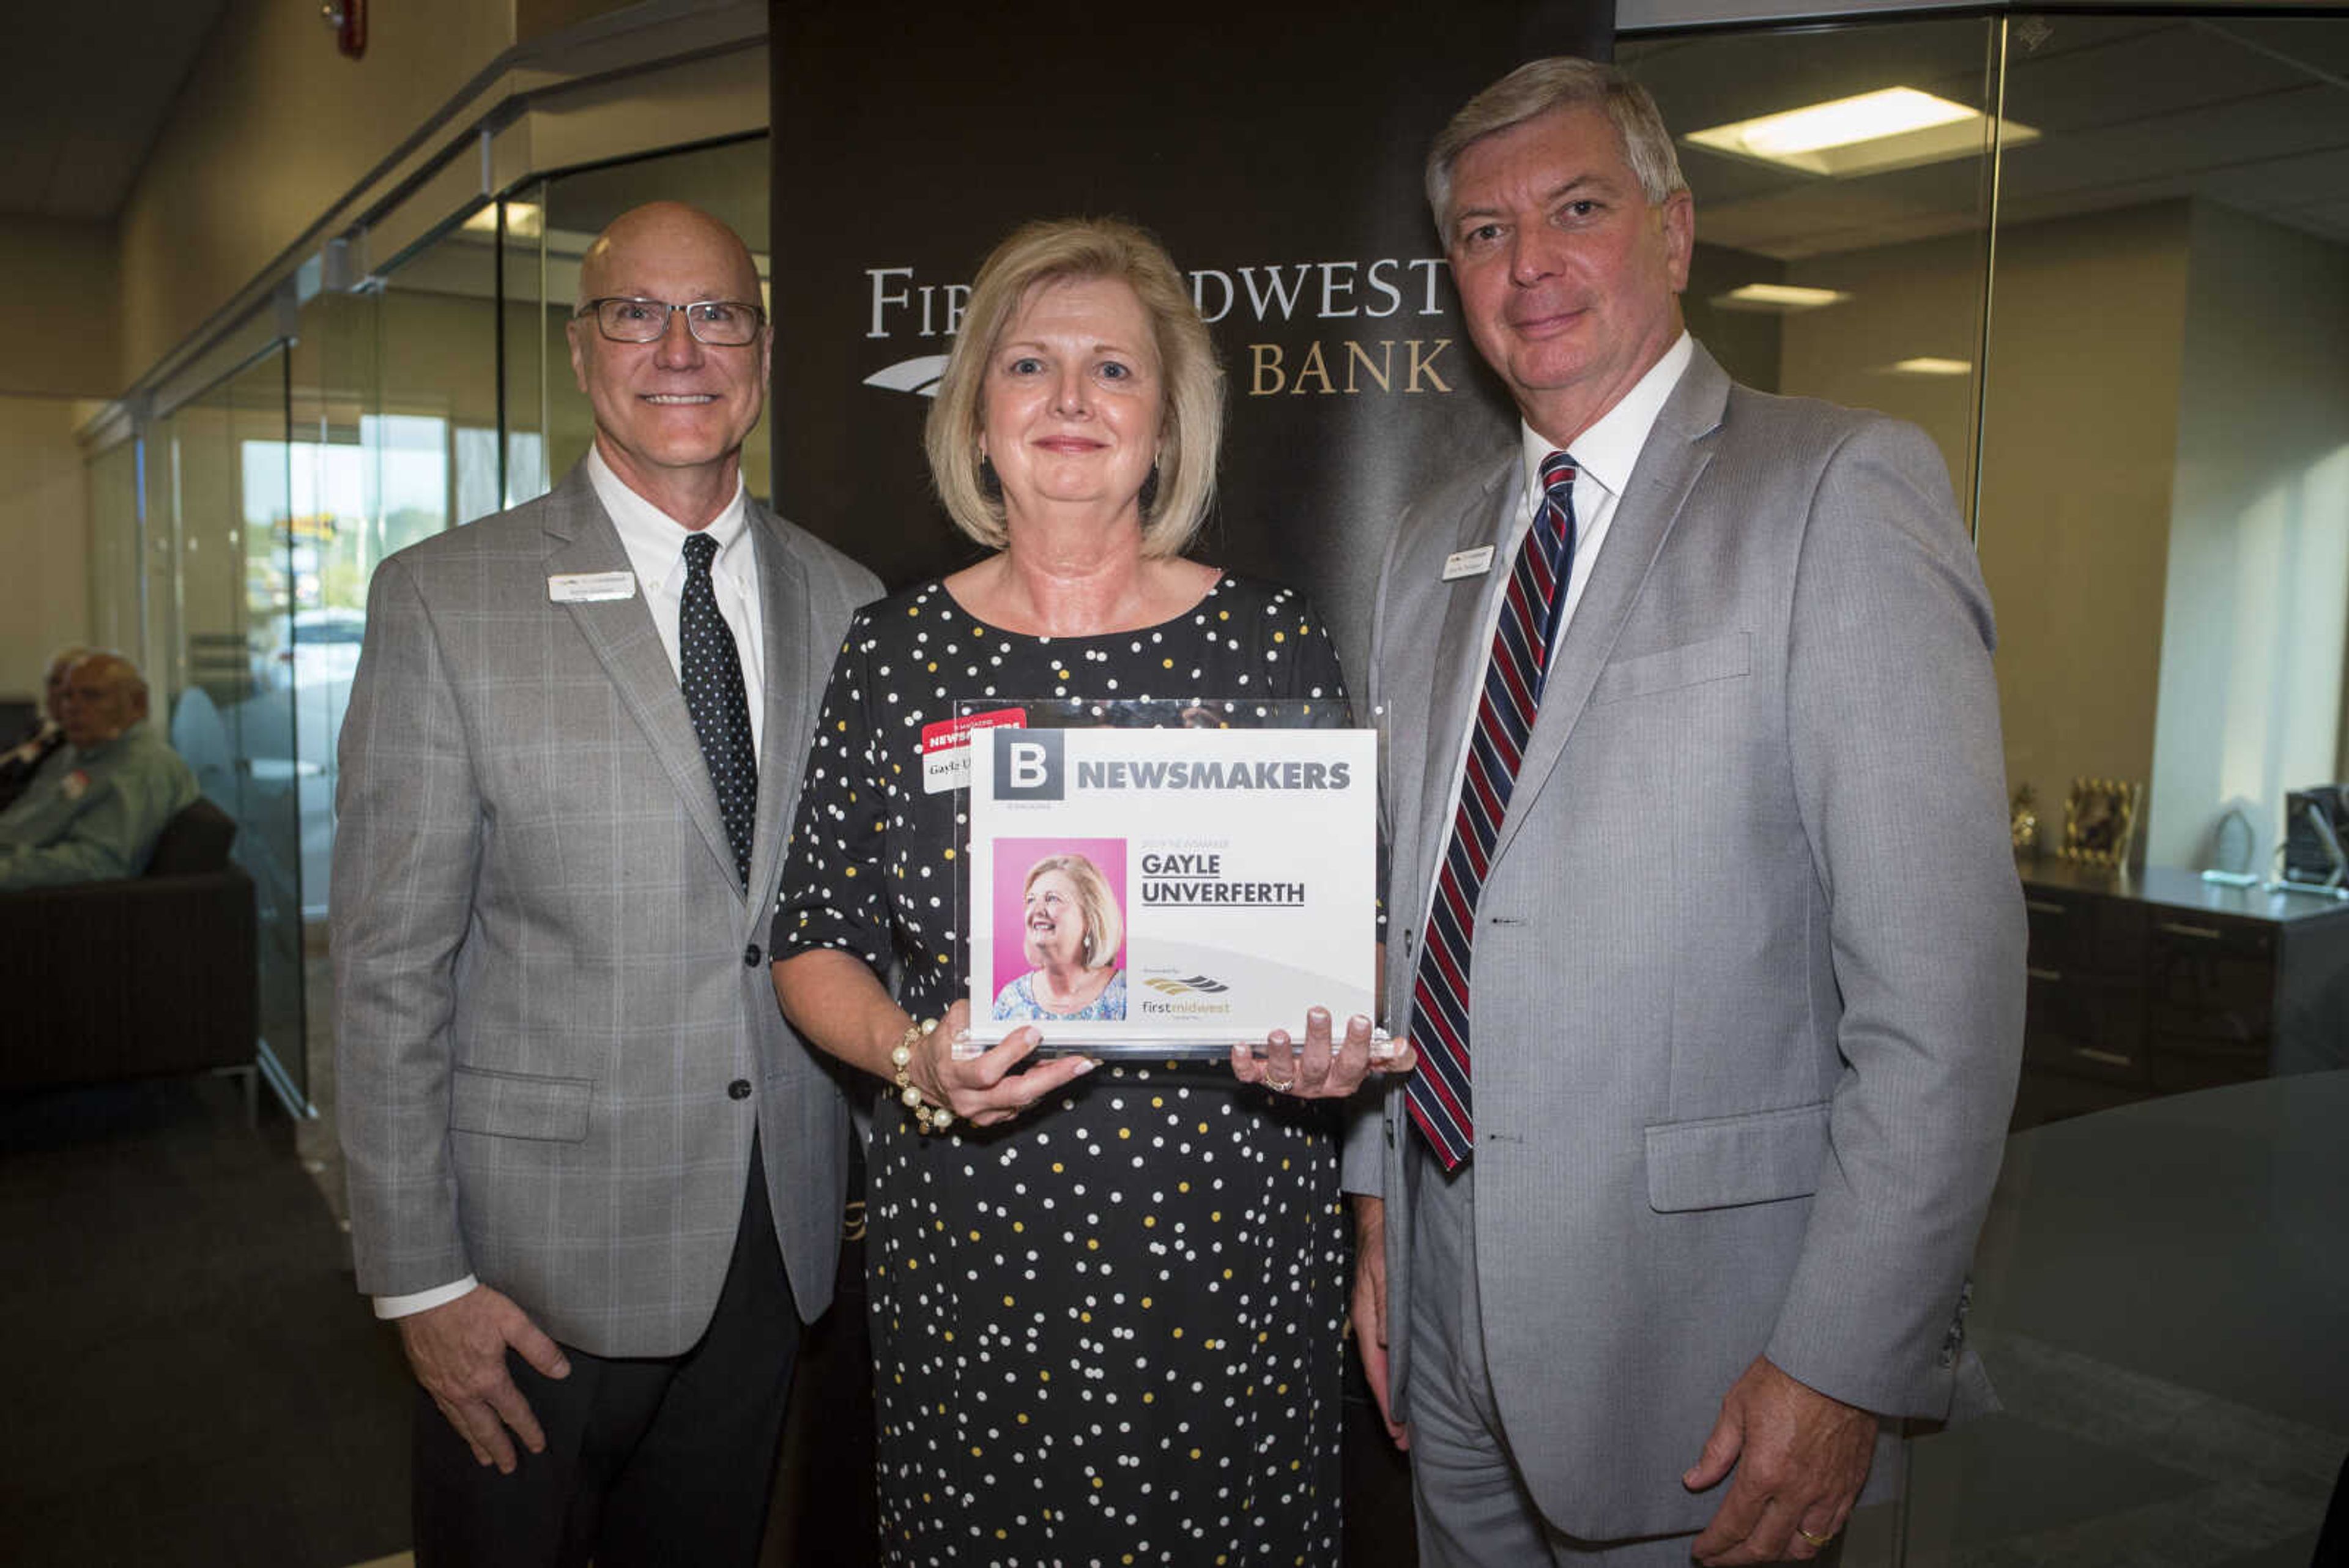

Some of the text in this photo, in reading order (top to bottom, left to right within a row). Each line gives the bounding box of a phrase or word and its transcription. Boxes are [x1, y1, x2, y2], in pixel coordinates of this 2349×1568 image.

[866, 259, 1450, 338] FIR DWEST
[1249, 339, 1453, 396] BANK
[1011, 743, 1351, 790] B NEWSMAKERS
[1141, 854, 1220, 874] GAYLE
[1141, 882, 1305, 902] UNVERFERTH
